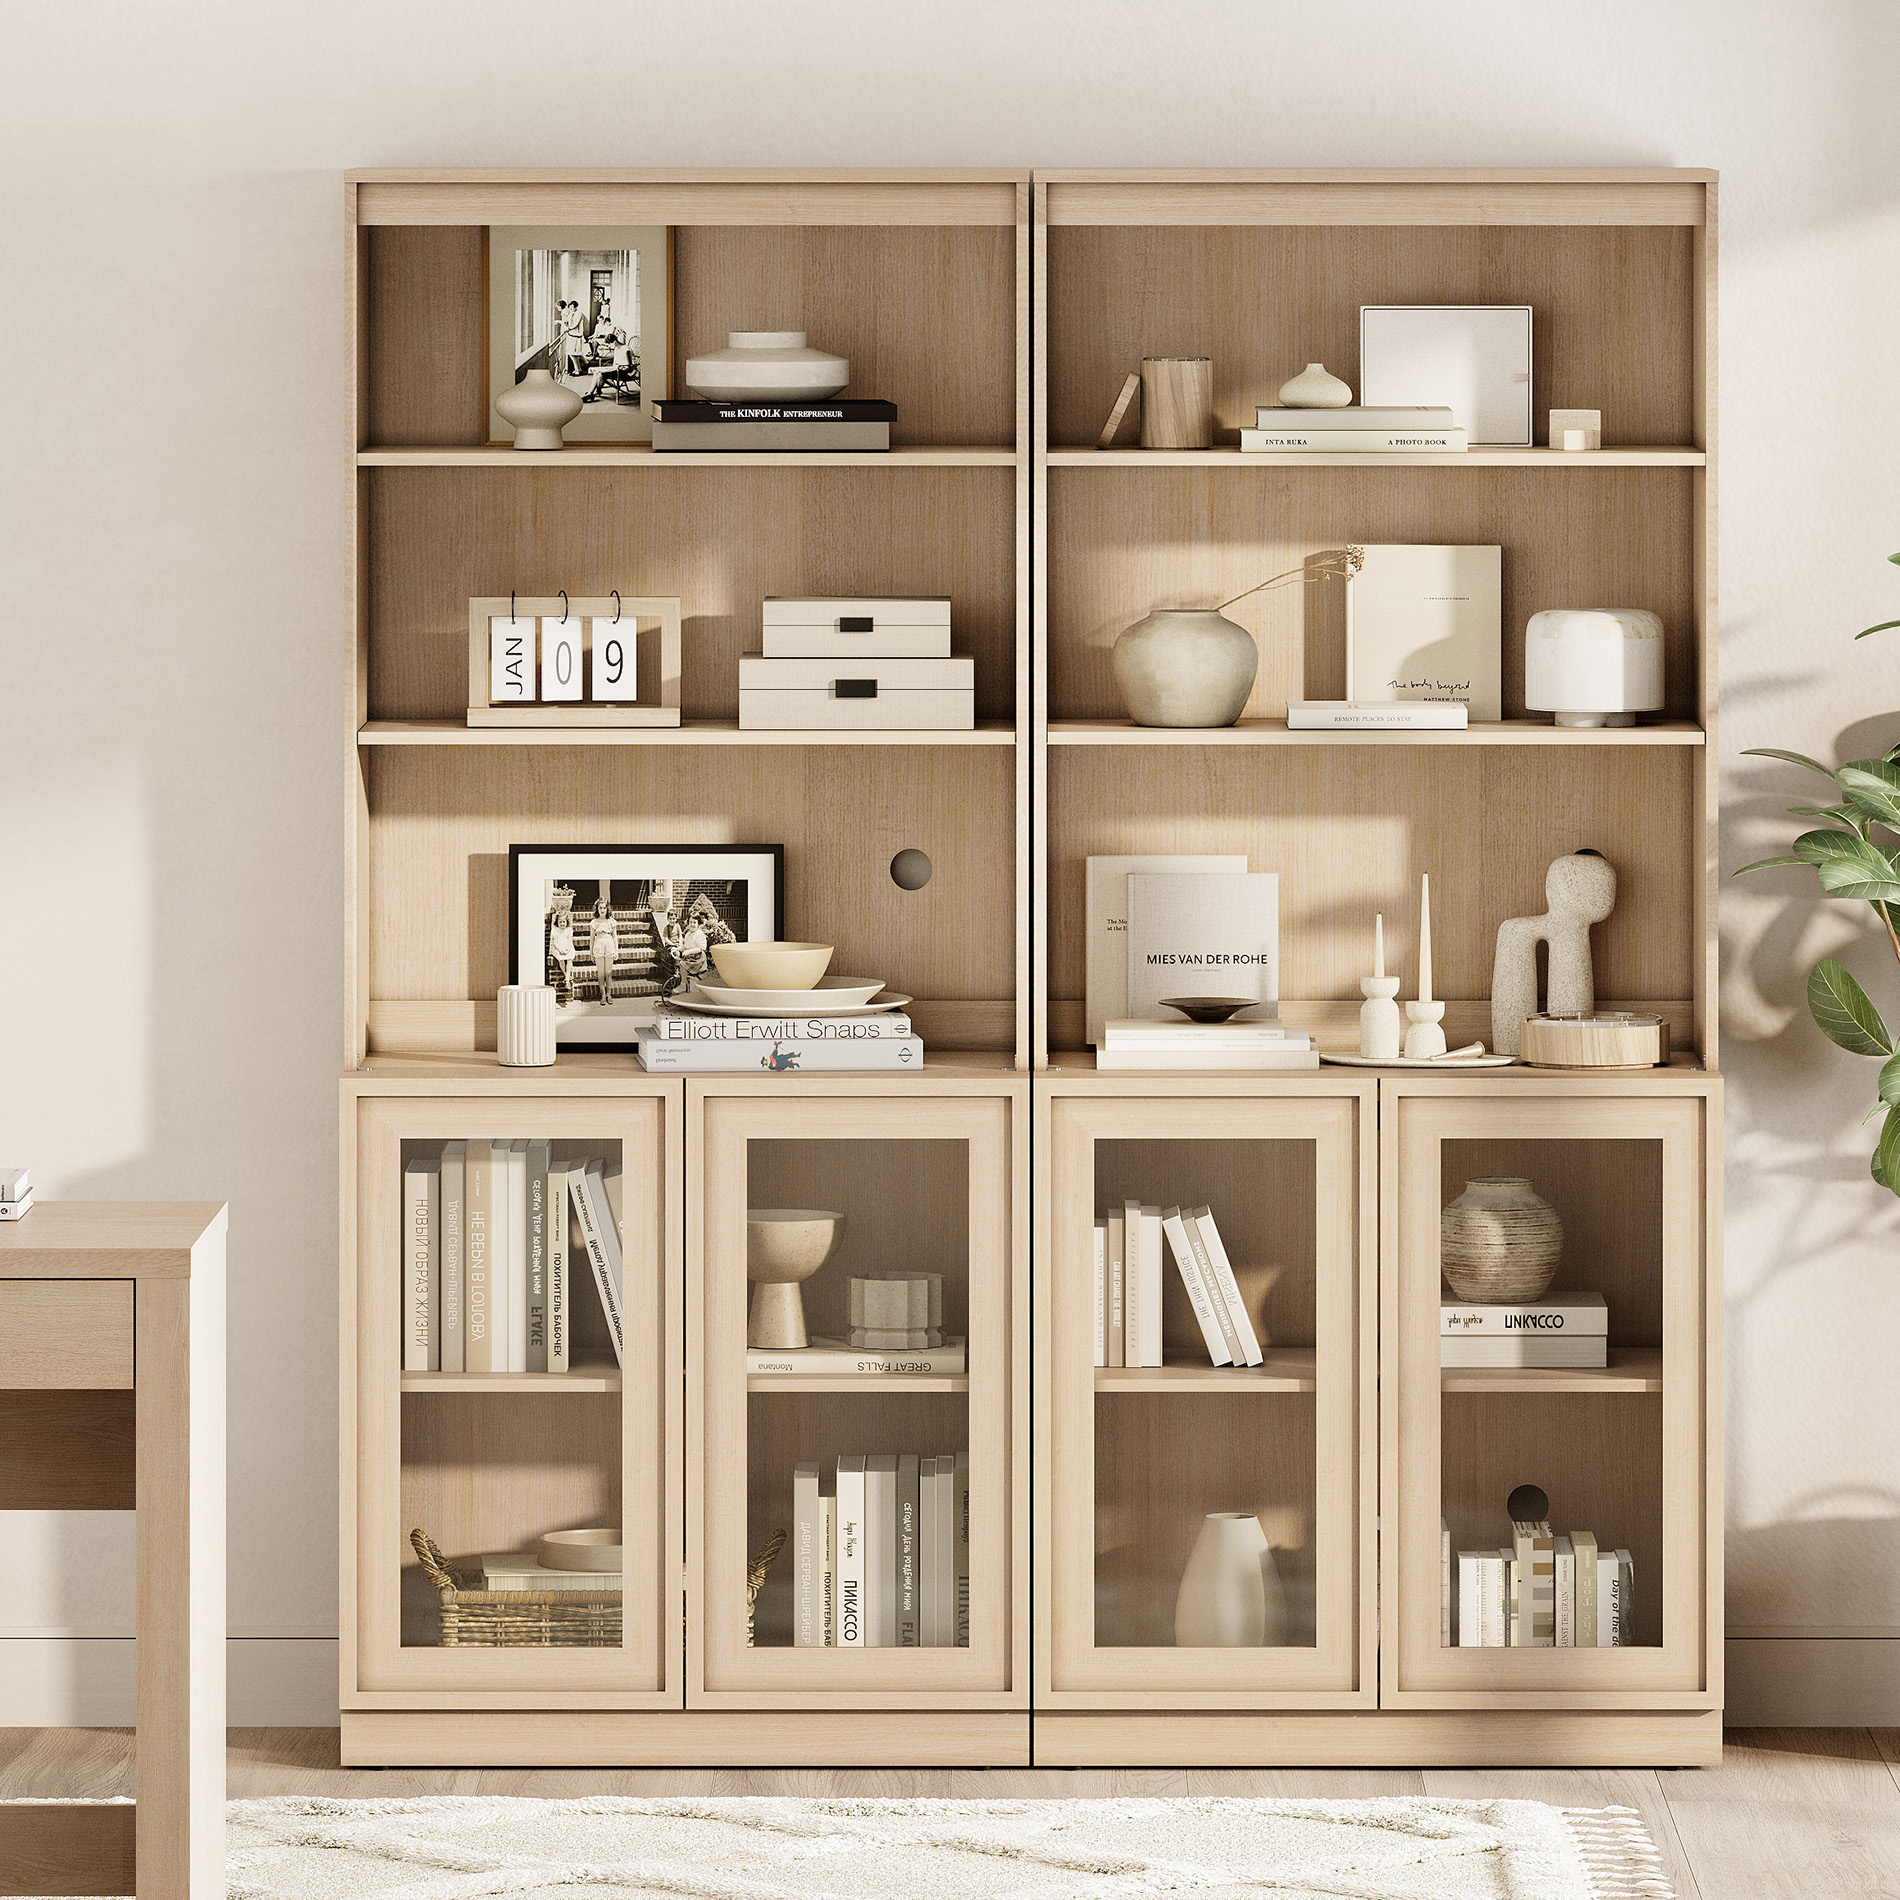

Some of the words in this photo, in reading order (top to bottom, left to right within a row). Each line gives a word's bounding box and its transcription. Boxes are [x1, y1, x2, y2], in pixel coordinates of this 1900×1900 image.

[719, 410, 736, 418] THE
[737, 408, 781, 418] KINFOLK
[783, 410, 844, 418] ENTREPRENEUR
[505, 637, 523, 695] JAN
[555, 640, 572, 685] 0
[605, 639, 624, 684] 9
[1387, 680, 1408, 690] The
[1410, 678, 1432, 690] body
[1146, 954, 1176, 965] MIES
[1177, 954, 1203, 965] VAN
[1206, 954, 1230, 965] DER
[1233, 954, 1268, 965] ROHE
[668, 1020, 727, 1039] Elliott
[736, 1020, 799, 1039] Erwitt
[806, 1019, 880, 1039] Snaps
[415, 1199, 432, 1248] НОВЫЙ
[415, 1251, 429, 1294] ОБРАЗ
[553, 1252, 562, 1312] ПОХИТИТЕЛЬ
[415, 1297, 429, 1347] ЖИЗНИ
[553, 1314, 562, 1357] БАБОЧЕК
[757, 1363, 793, 1371] Montana
[857, 1361, 891, 1372] FALLS
[893, 1362, 932, 1372] GREAT
[800, 1521, 811, 1555] ДАВИД
[823, 1571, 832, 1628] ПОХИТИТЕЛЬ
[1611, 1579, 1620, 1600] Day
[843, 1580, 858, 1641] ПИКАССО
[1561, 1591, 1569, 1612] GRAIN
[1611, 1602, 1620, 1613] of
[1561, 1612, 1569, 1626] THE
[1611, 1615, 1620, 1633] the
[902, 1622, 914, 1647] FLA
